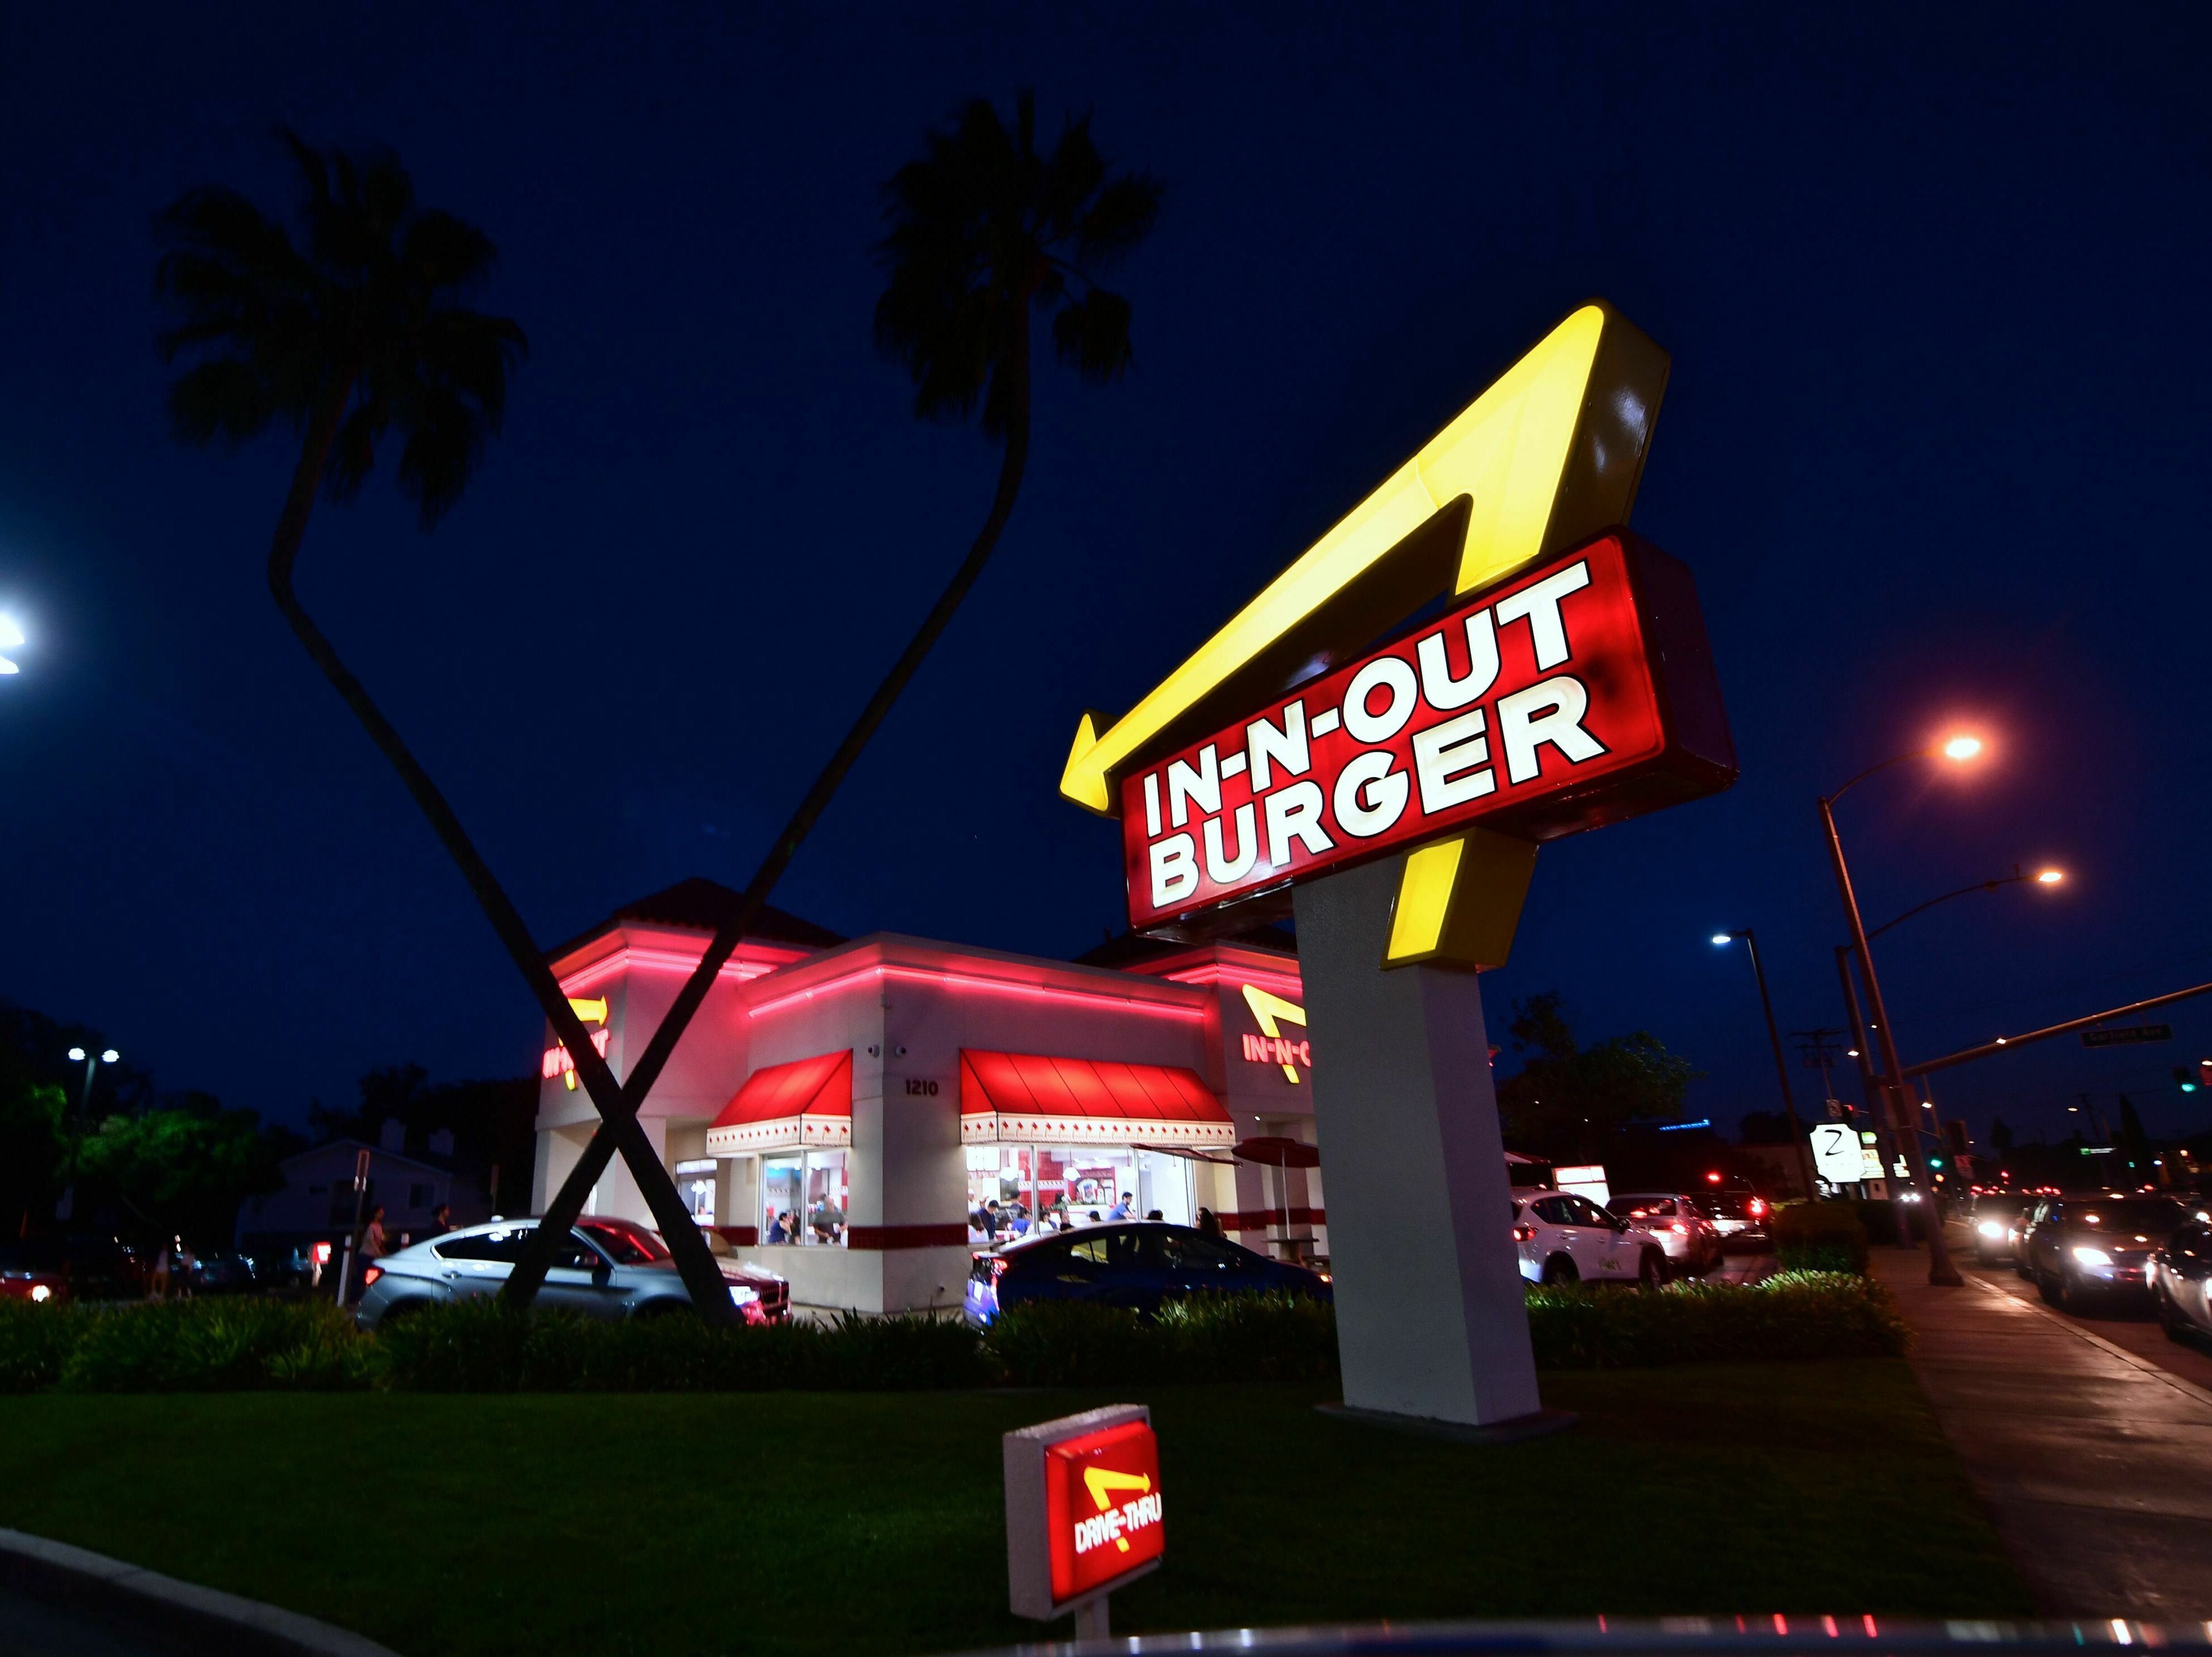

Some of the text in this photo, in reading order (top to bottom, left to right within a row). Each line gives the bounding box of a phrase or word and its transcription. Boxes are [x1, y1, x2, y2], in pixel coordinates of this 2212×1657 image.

[1143, 559, 1592, 839] IN-N-OUT
[1148, 675, 1610, 909] BURGER
[906, 1079, 939, 1096] 1210
[1074, 1492, 1163, 1554] DRIVE-THRU
